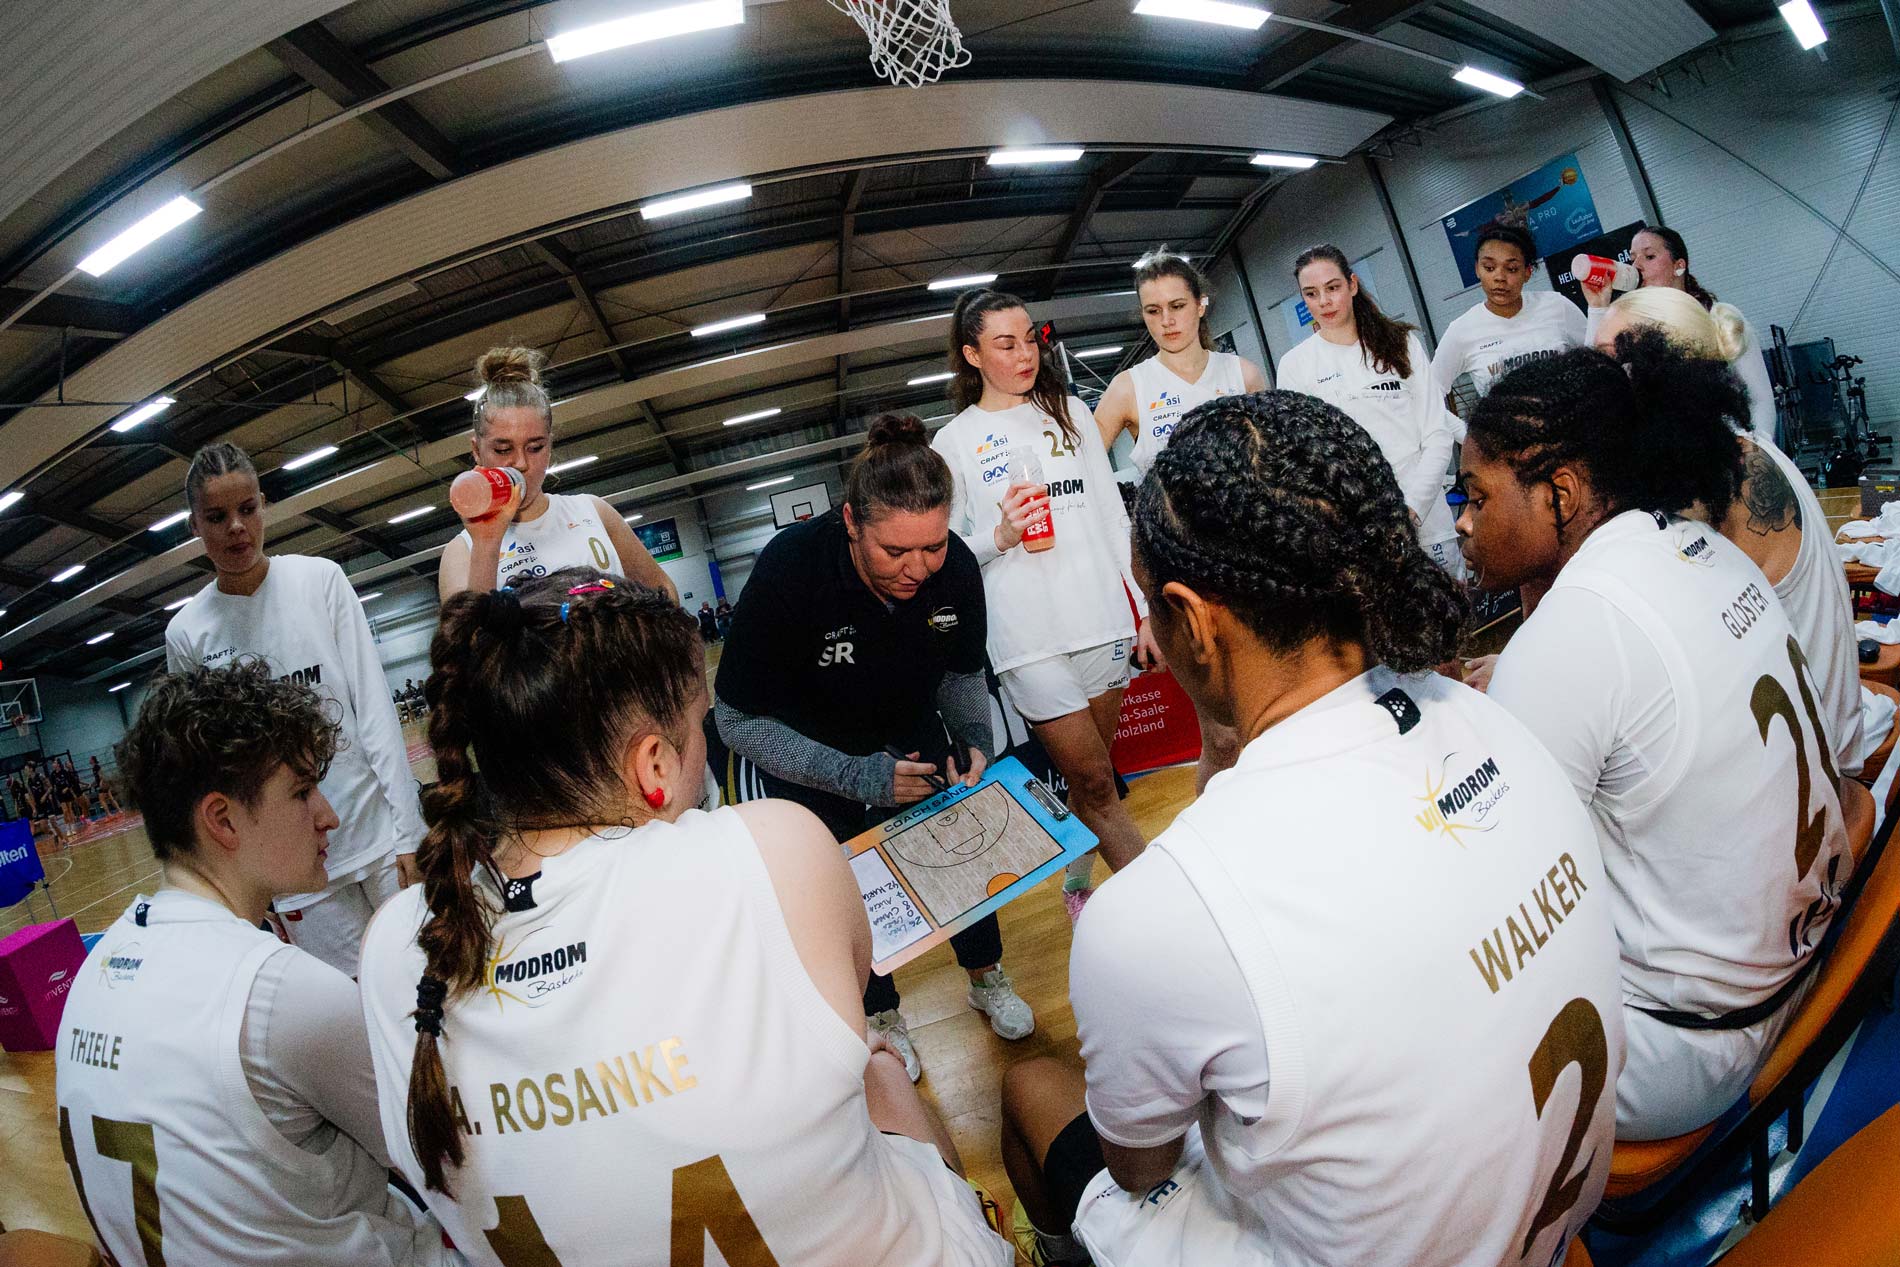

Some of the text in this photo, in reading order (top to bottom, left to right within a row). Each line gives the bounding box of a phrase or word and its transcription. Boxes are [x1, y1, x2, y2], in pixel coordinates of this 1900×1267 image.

[1537, 207, 1557, 220] PRO
[1166, 395, 1181, 406] asi
[1153, 412, 1175, 421] CRAFT
[993, 434, 1008, 447] asi
[1043, 430, 1076, 457] 24
[980, 452, 1004, 465] CRAFT
[517, 542, 535, 555] asi
[588, 537, 610, 570] 0
[500, 559, 530, 574] CRAFT
[1721, 582, 1769, 640] GLOSTER
[824, 627, 849, 640] CRAFT
[203, 649, 229, 664] CRAFT
[818, 642, 855, 667] SR
[1121, 690, 1161, 707] rkasse
[1471, 782, 1510, 823] Baskets
[884, 805, 931, 833] COACH
[0, 845, 28, 868] lten
[902, 900, 911, 911] 8
[1469, 852, 1587, 994] WALKER
[495, 941, 587, 985] MODROM
[528, 969, 583, 998] Baskets
[71, 1028, 122, 1070] THIELE
[489, 1036, 697, 1135] ROSANKE
